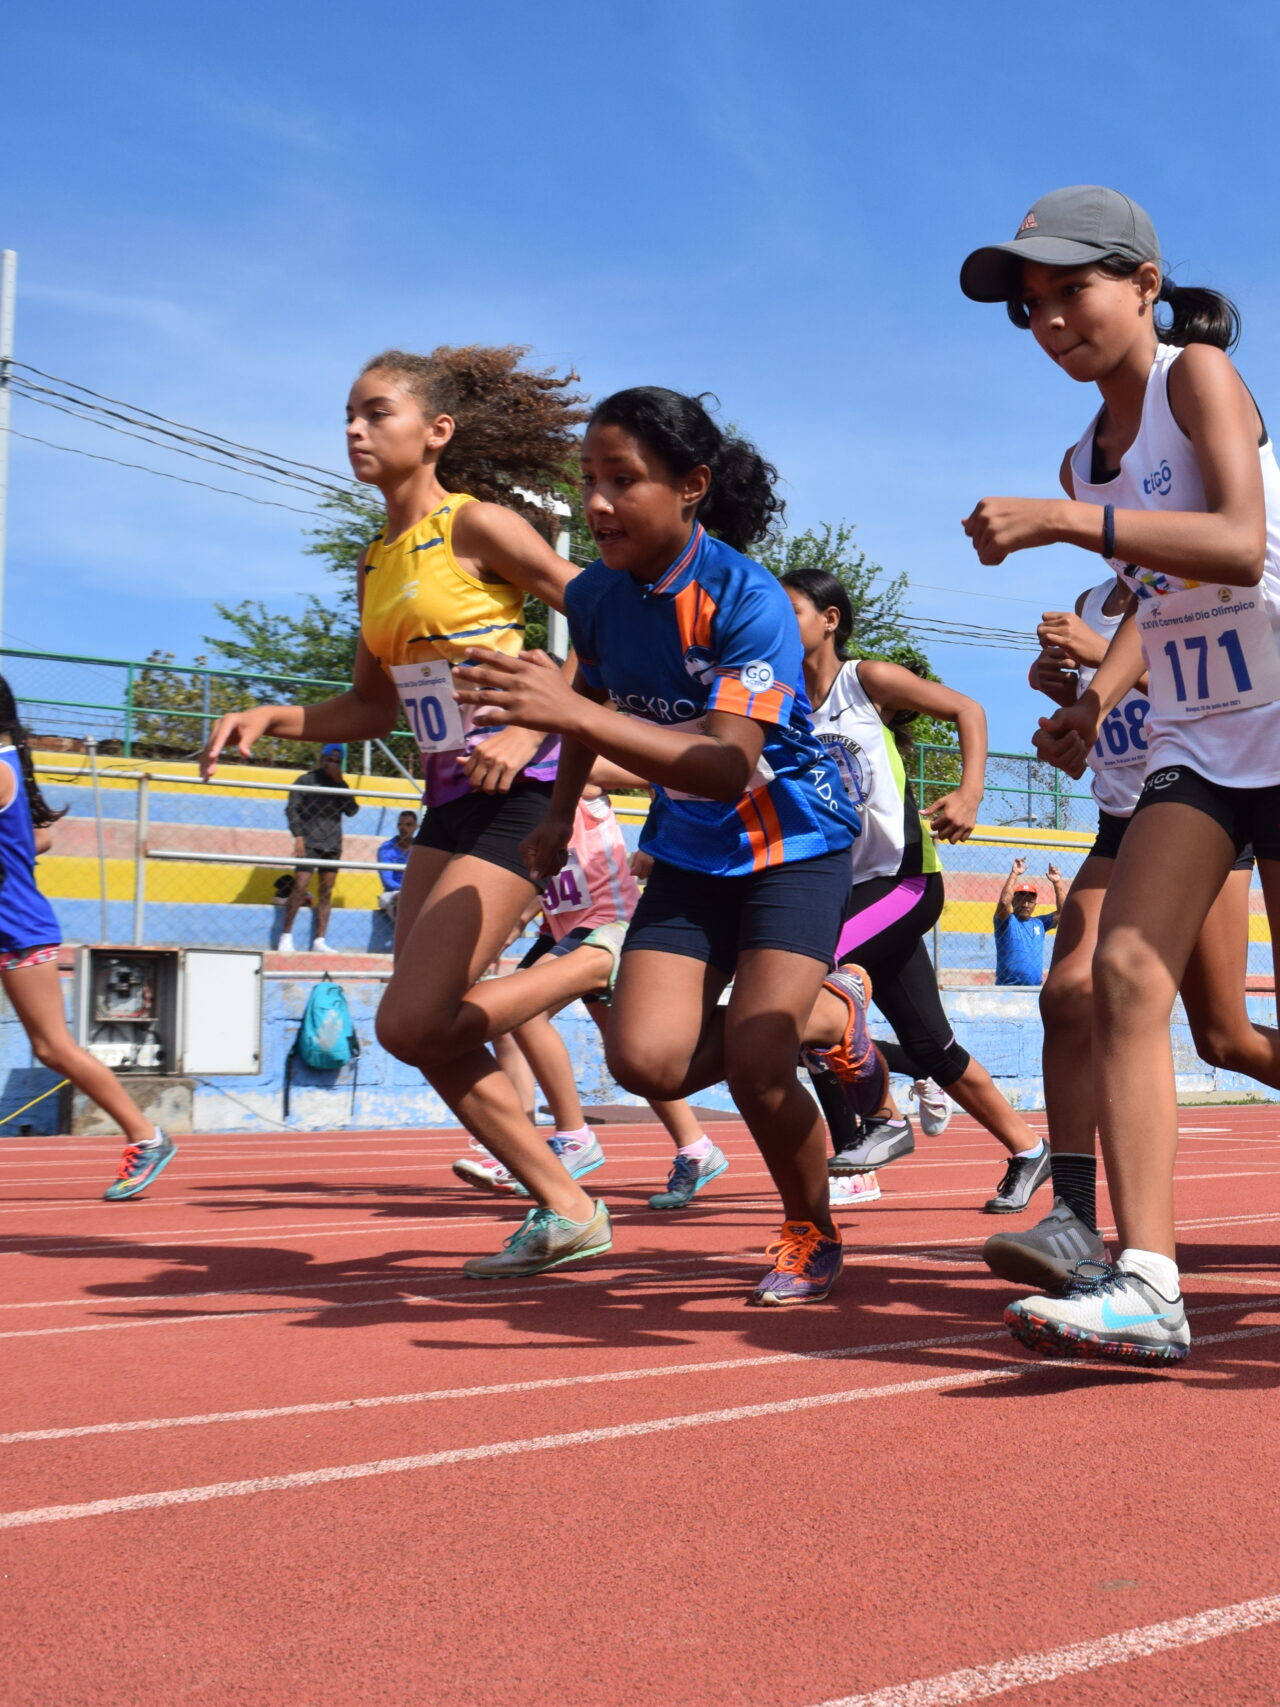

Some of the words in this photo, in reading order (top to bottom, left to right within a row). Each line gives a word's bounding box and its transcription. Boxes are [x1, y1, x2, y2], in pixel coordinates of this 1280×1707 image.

[1159, 616, 1184, 627] Carrera
[1184, 613, 1195, 623] del
[745, 665, 771, 682] GO
[1164, 629, 1253, 702] 171
[404, 696, 447, 742] 70
